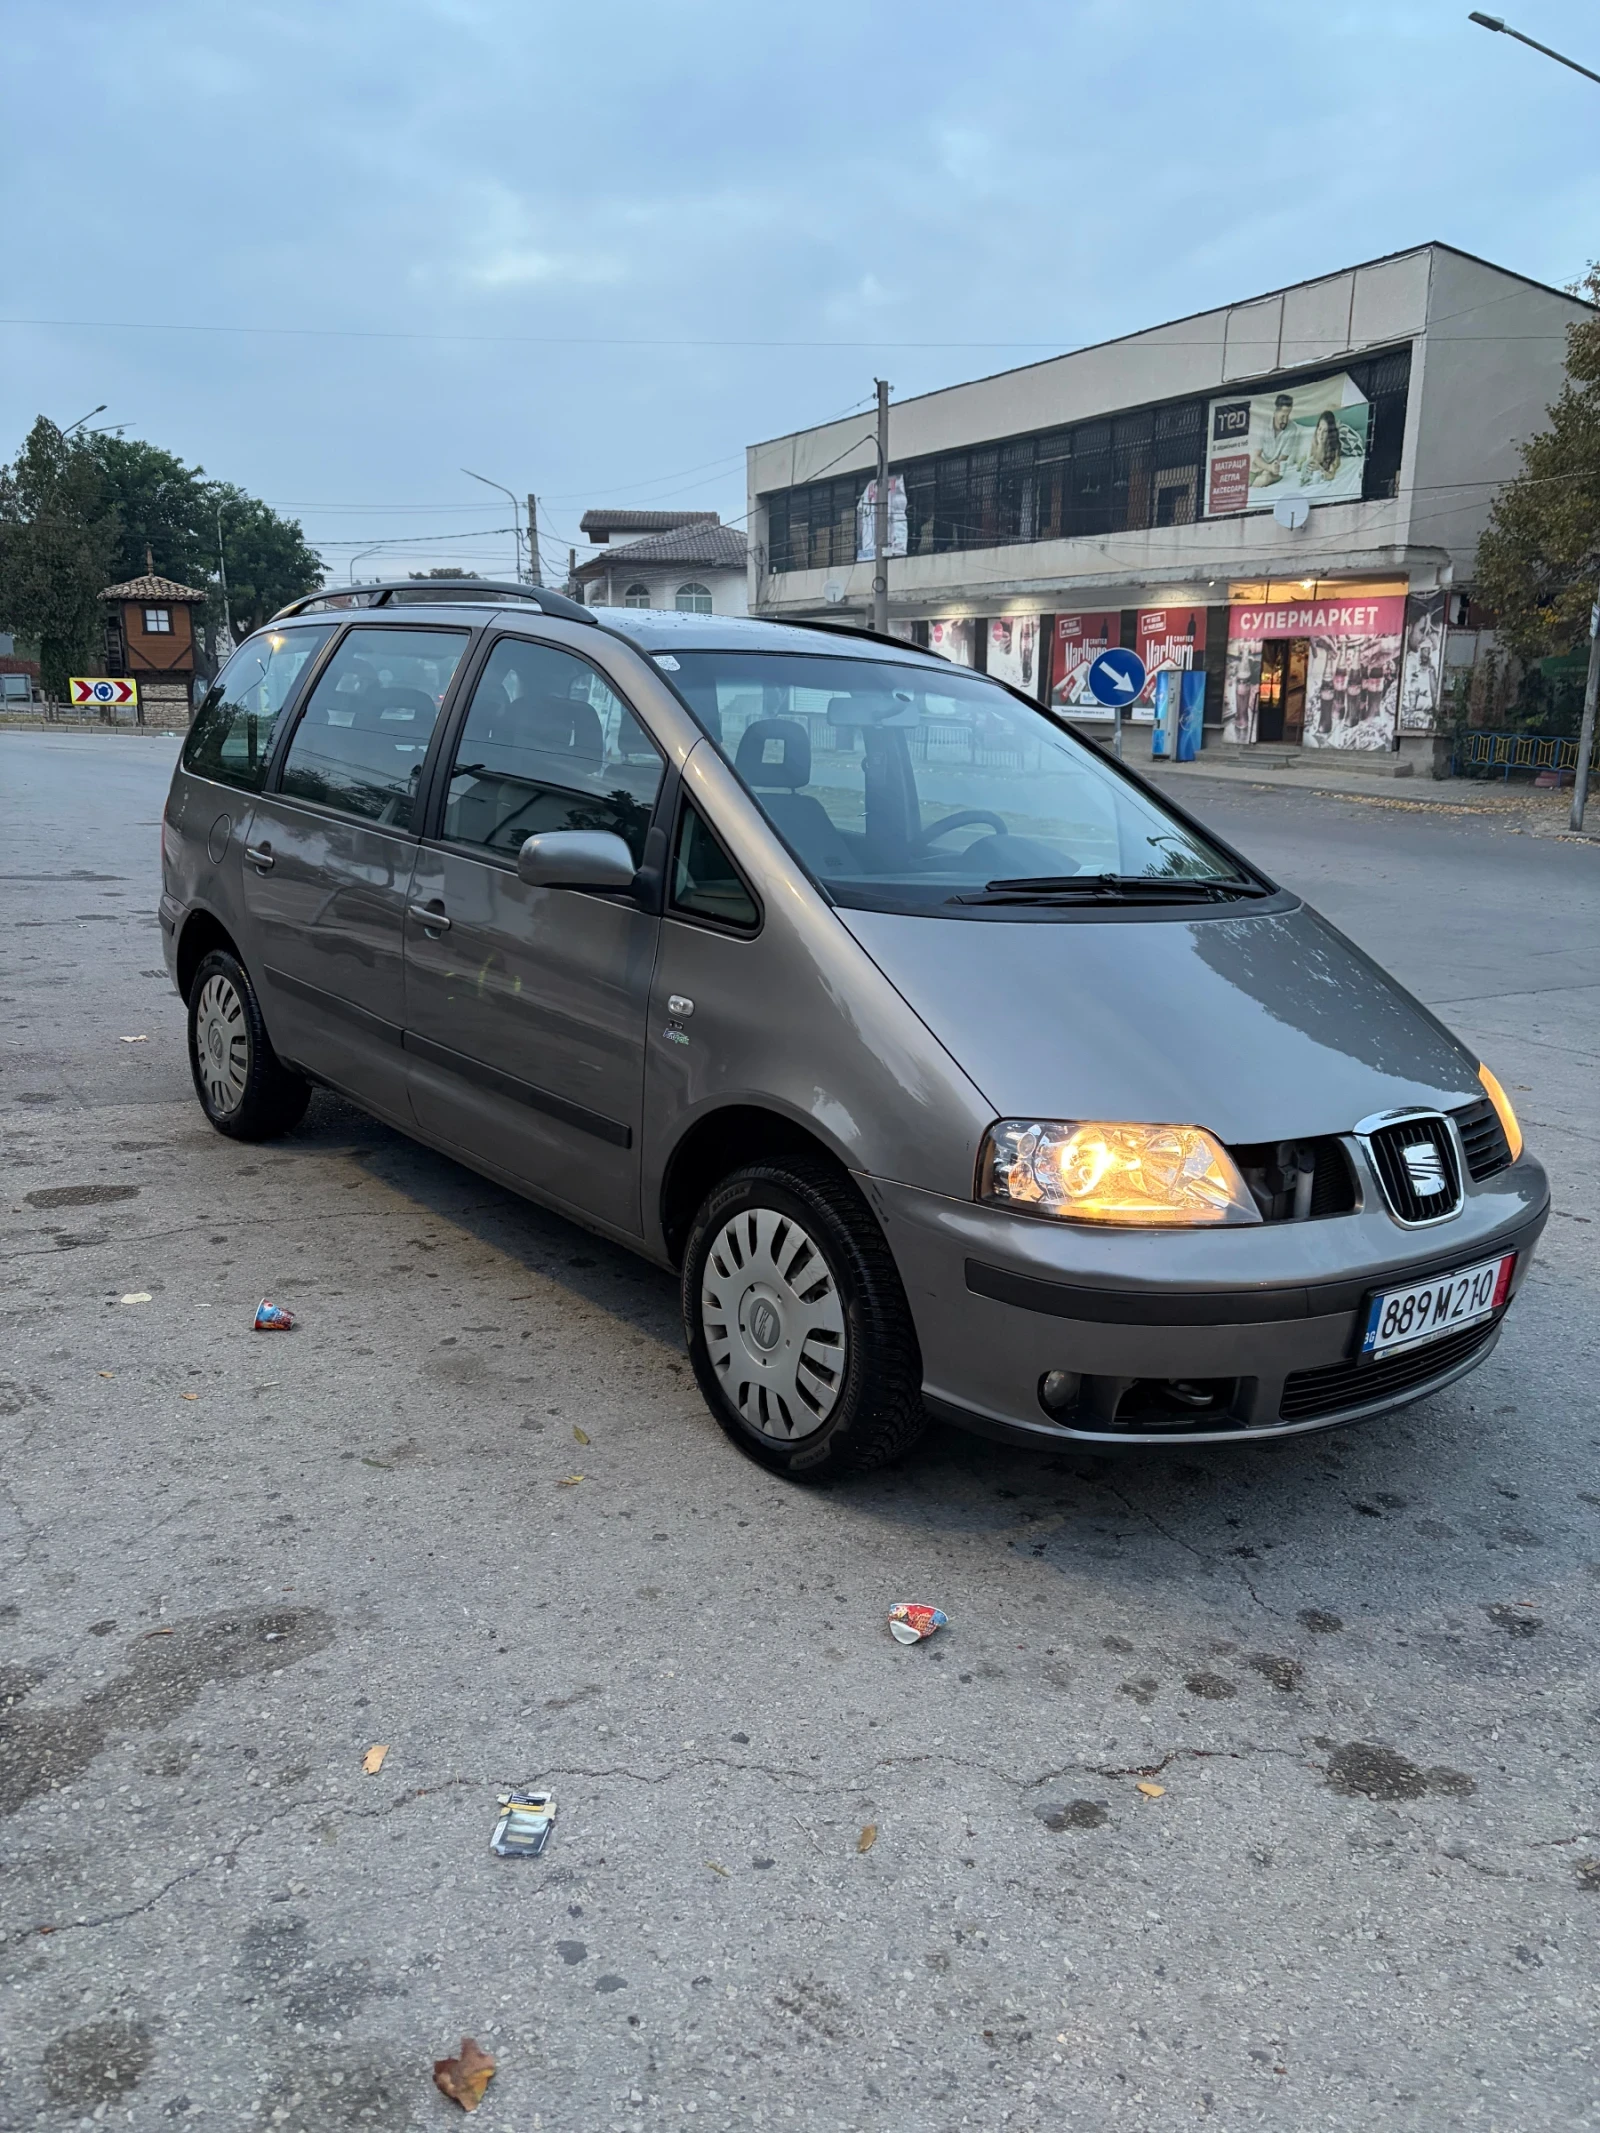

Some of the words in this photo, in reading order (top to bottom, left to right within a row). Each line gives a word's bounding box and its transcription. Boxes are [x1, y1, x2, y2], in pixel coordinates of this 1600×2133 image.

[1214, 459, 1247, 471] МАТРАЦИ
[1219, 473, 1240, 483] ЛЕГЛА
[1240, 606, 1379, 630] СУПЕРМАРКЕТ
